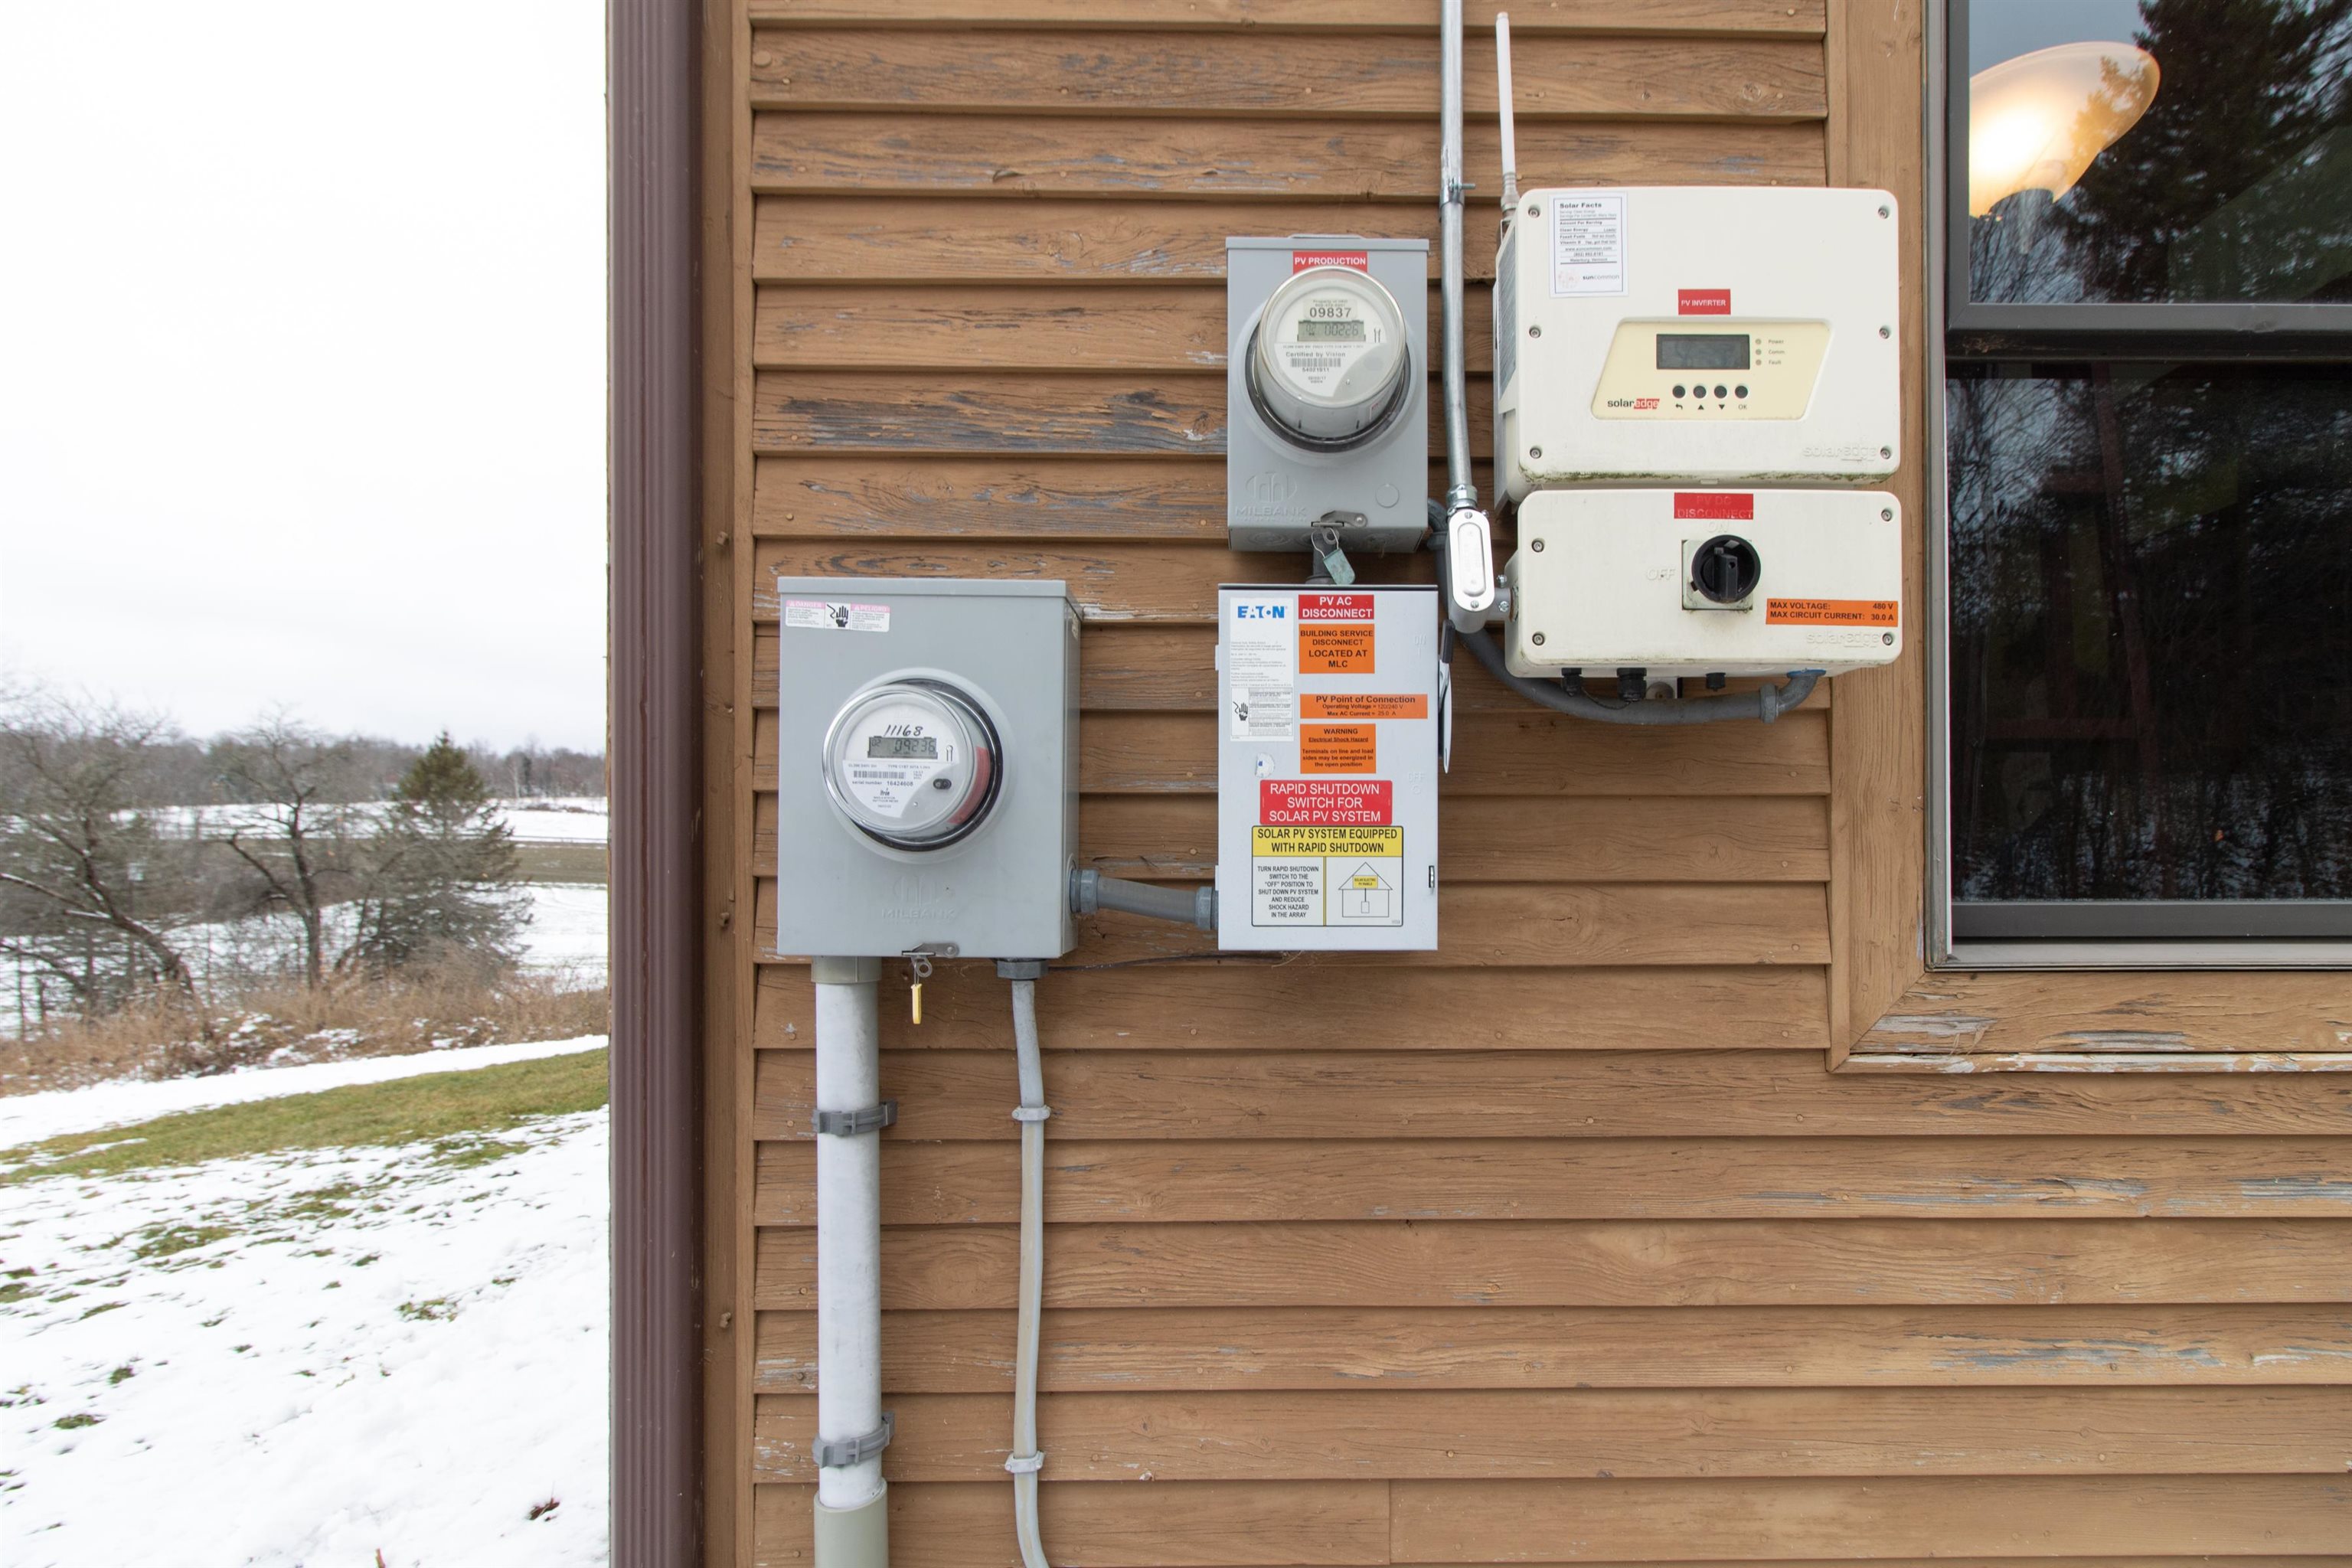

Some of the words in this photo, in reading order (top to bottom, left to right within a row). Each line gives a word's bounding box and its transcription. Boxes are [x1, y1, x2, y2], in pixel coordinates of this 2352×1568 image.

[1309, 307, 1351, 318] 09837
[1608, 398, 1660, 410] solaredge
[1697, 496, 1710, 505] PV
[1715, 496, 1732, 505] DC
[1235, 506, 1308, 516] MILBANK
[1677, 508, 1753, 519] DISCONNECT
[1647, 568, 1675, 581] OFF
[1319, 596, 1334, 606] PV
[1336, 596, 1352, 606] AC
[1237, 606, 1285, 619] EATON
[1302, 608, 1373, 619] DISCONNECT
[1807, 630, 1880, 647] solaredge
[884, 724, 923, 737] 11168
[1270, 784, 1306, 795] RAPID
[1309, 784, 1380, 795] SHUTDOWN
[1287, 797, 1334, 808] SWITCH
[1338, 798, 1363, 808] FOR
[1269, 811, 1309, 822] SOLAR
[1313, 811, 1328, 822] PV
[1331, 811, 1380, 822] SYSTEM
[1257, 828, 1290, 838] SOLAR
[1293, 829, 1305, 838] PV
[1308, 828, 1347, 838] SYSTEM
[1350, 828, 1397, 839] EQUIPPED
[1272, 843, 1295, 852] WITH
[1298, 843, 1327, 852] RAPID
[1329, 843, 1384, 852] SHUTDOWN
